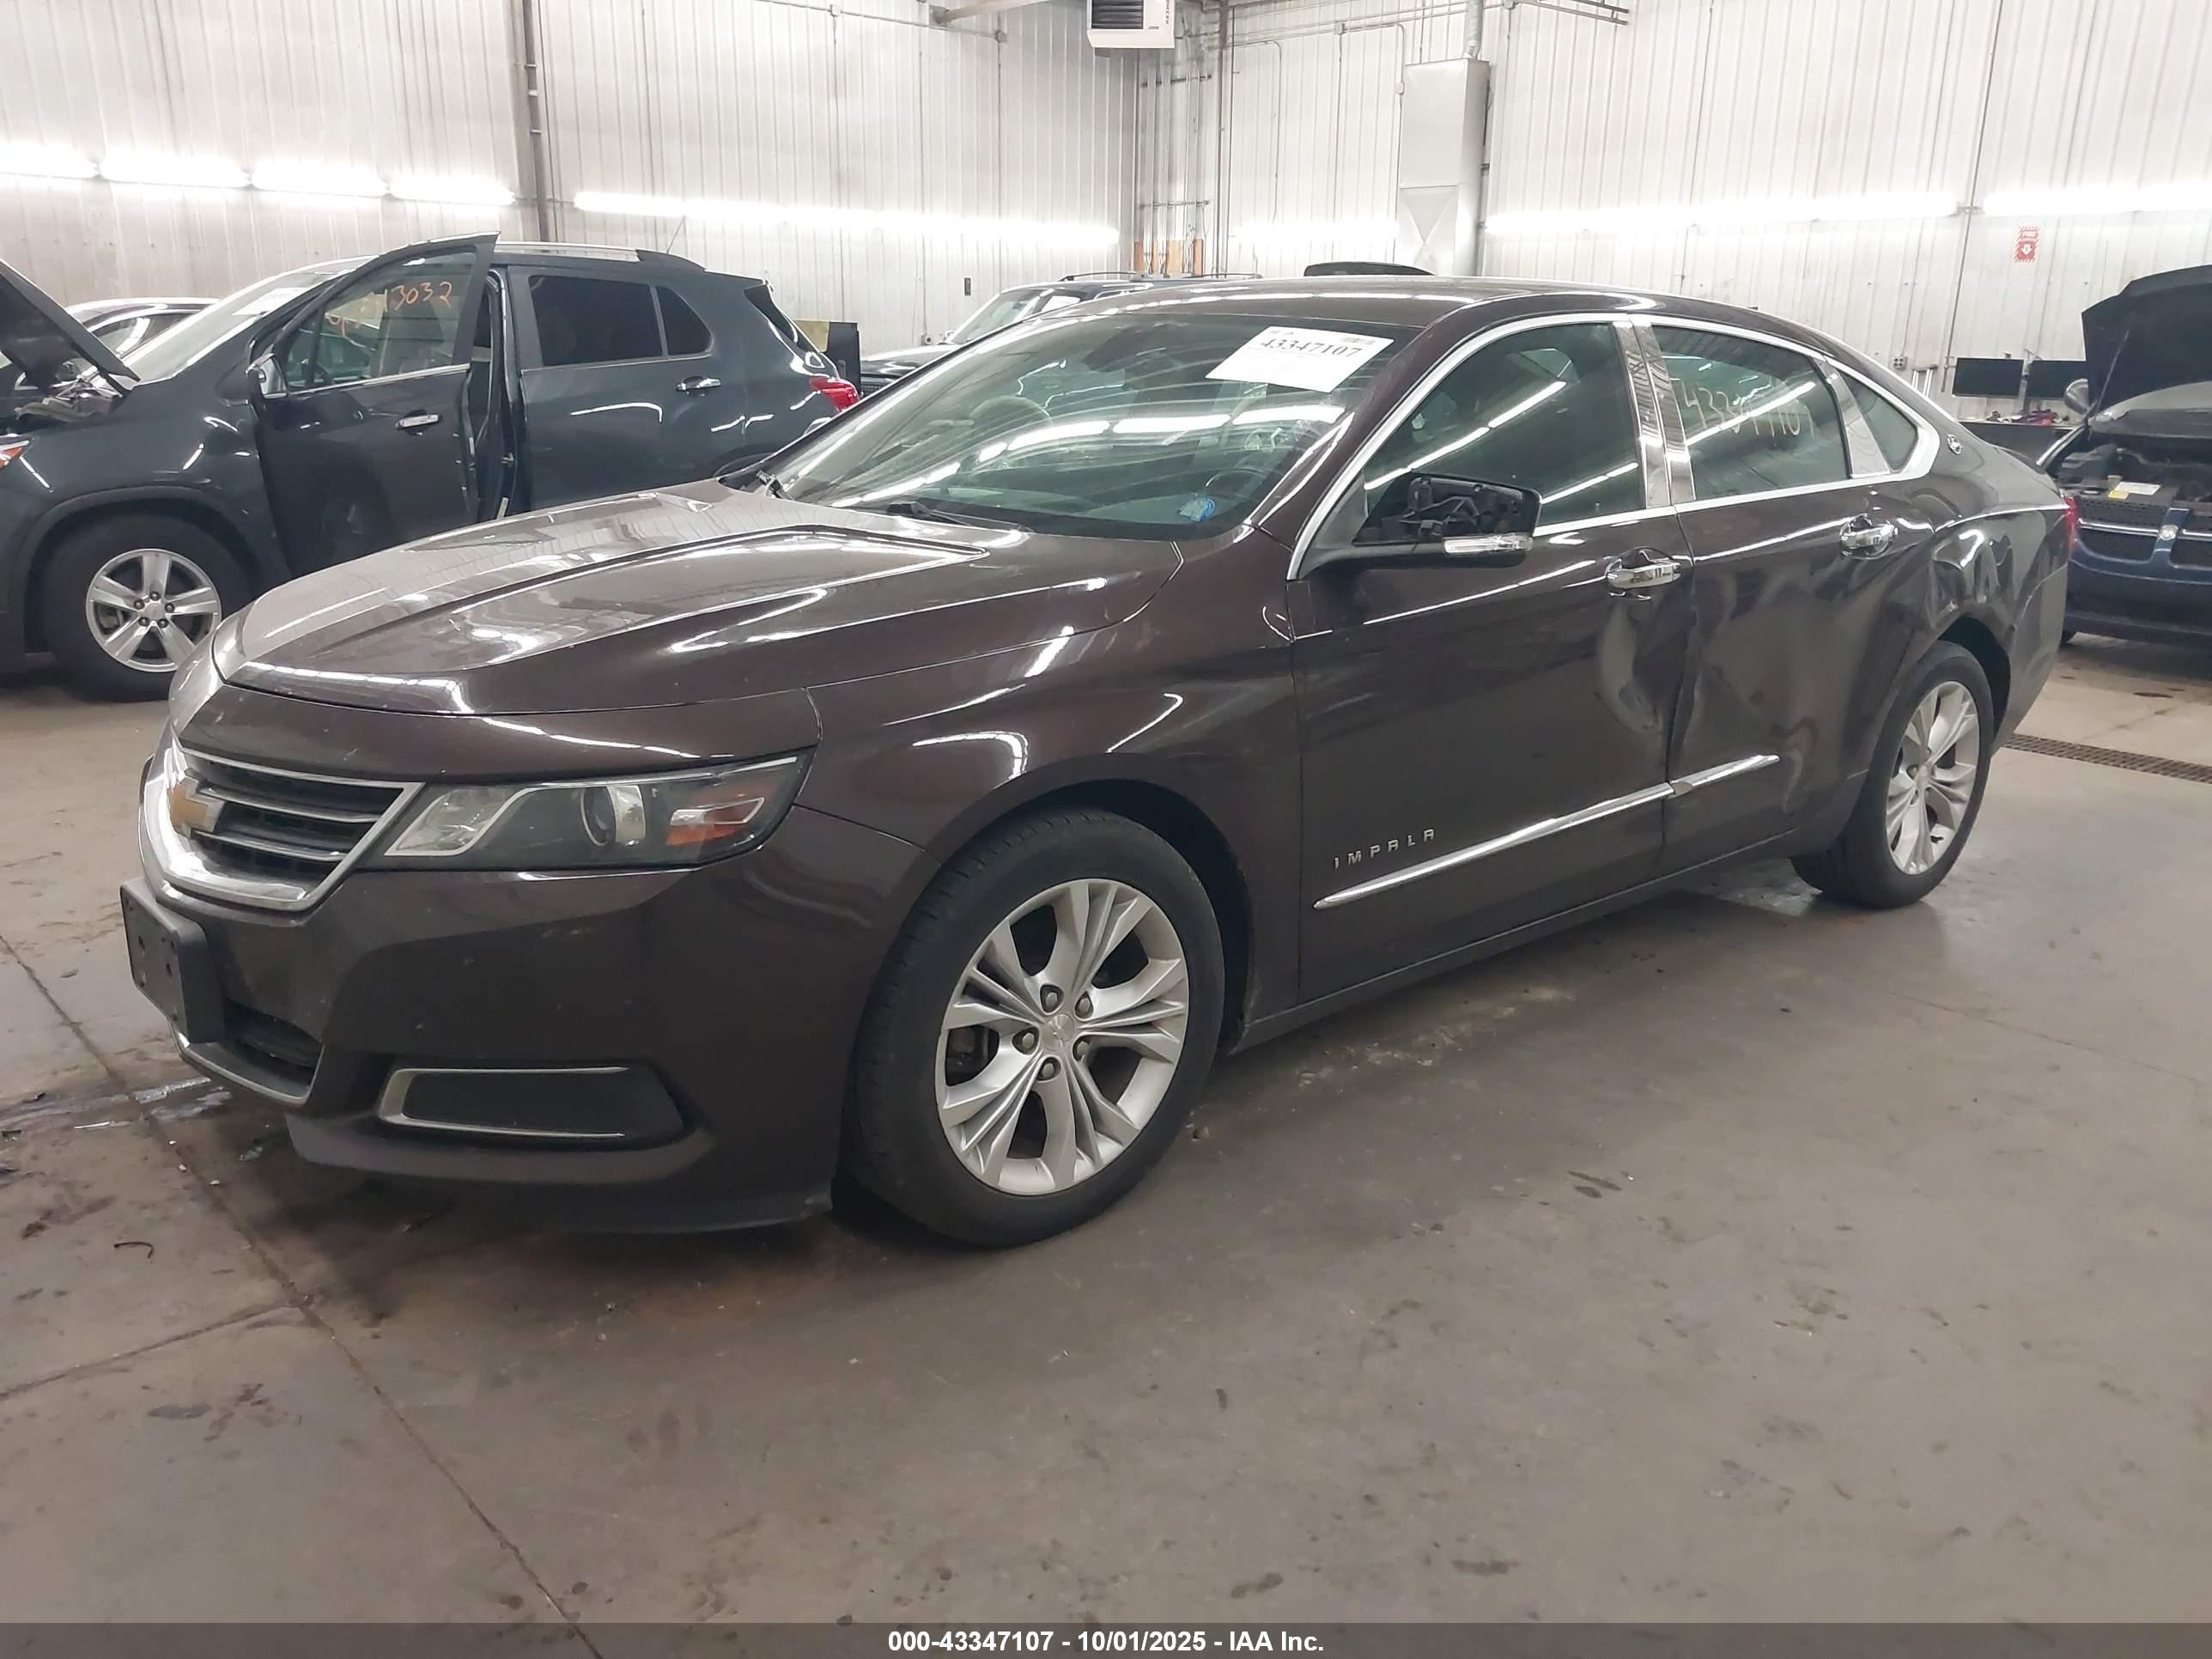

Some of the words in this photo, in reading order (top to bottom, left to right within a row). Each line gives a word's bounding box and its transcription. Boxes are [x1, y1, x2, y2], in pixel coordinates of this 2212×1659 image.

[325, 280, 453, 337] 43032
[1260, 337, 1364, 358] 43347107
[1334, 829, 1435, 869] IMPALA
